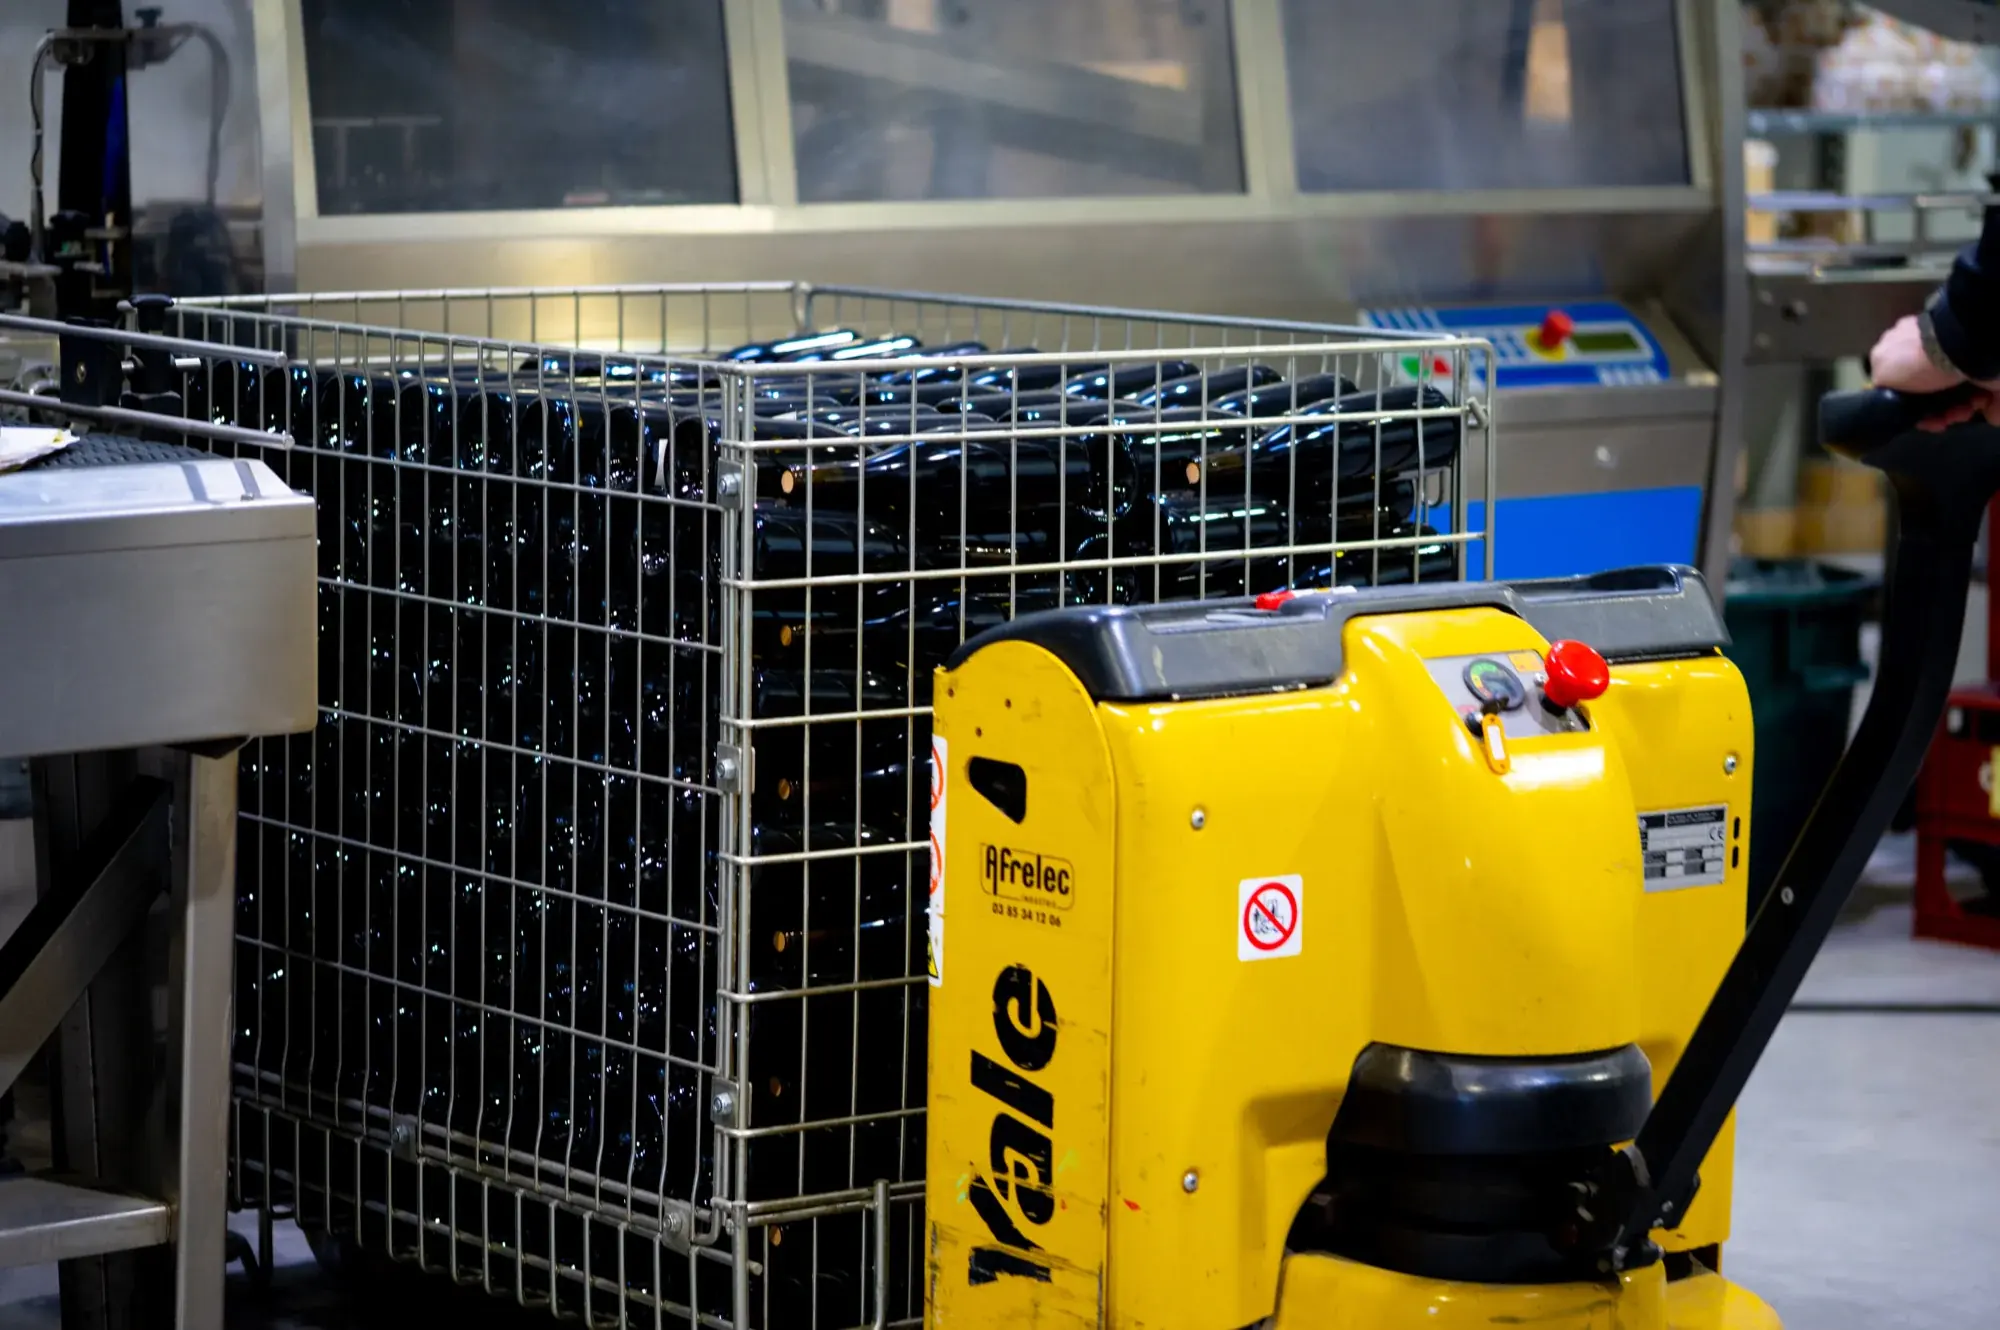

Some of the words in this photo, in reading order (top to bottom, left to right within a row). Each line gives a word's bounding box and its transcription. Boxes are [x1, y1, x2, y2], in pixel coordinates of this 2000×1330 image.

[986, 844, 1070, 896] Afrelec
[992, 902, 1004, 915] 03
[1036, 911, 1046, 924] 12
[968, 963, 1058, 1286] Yale
